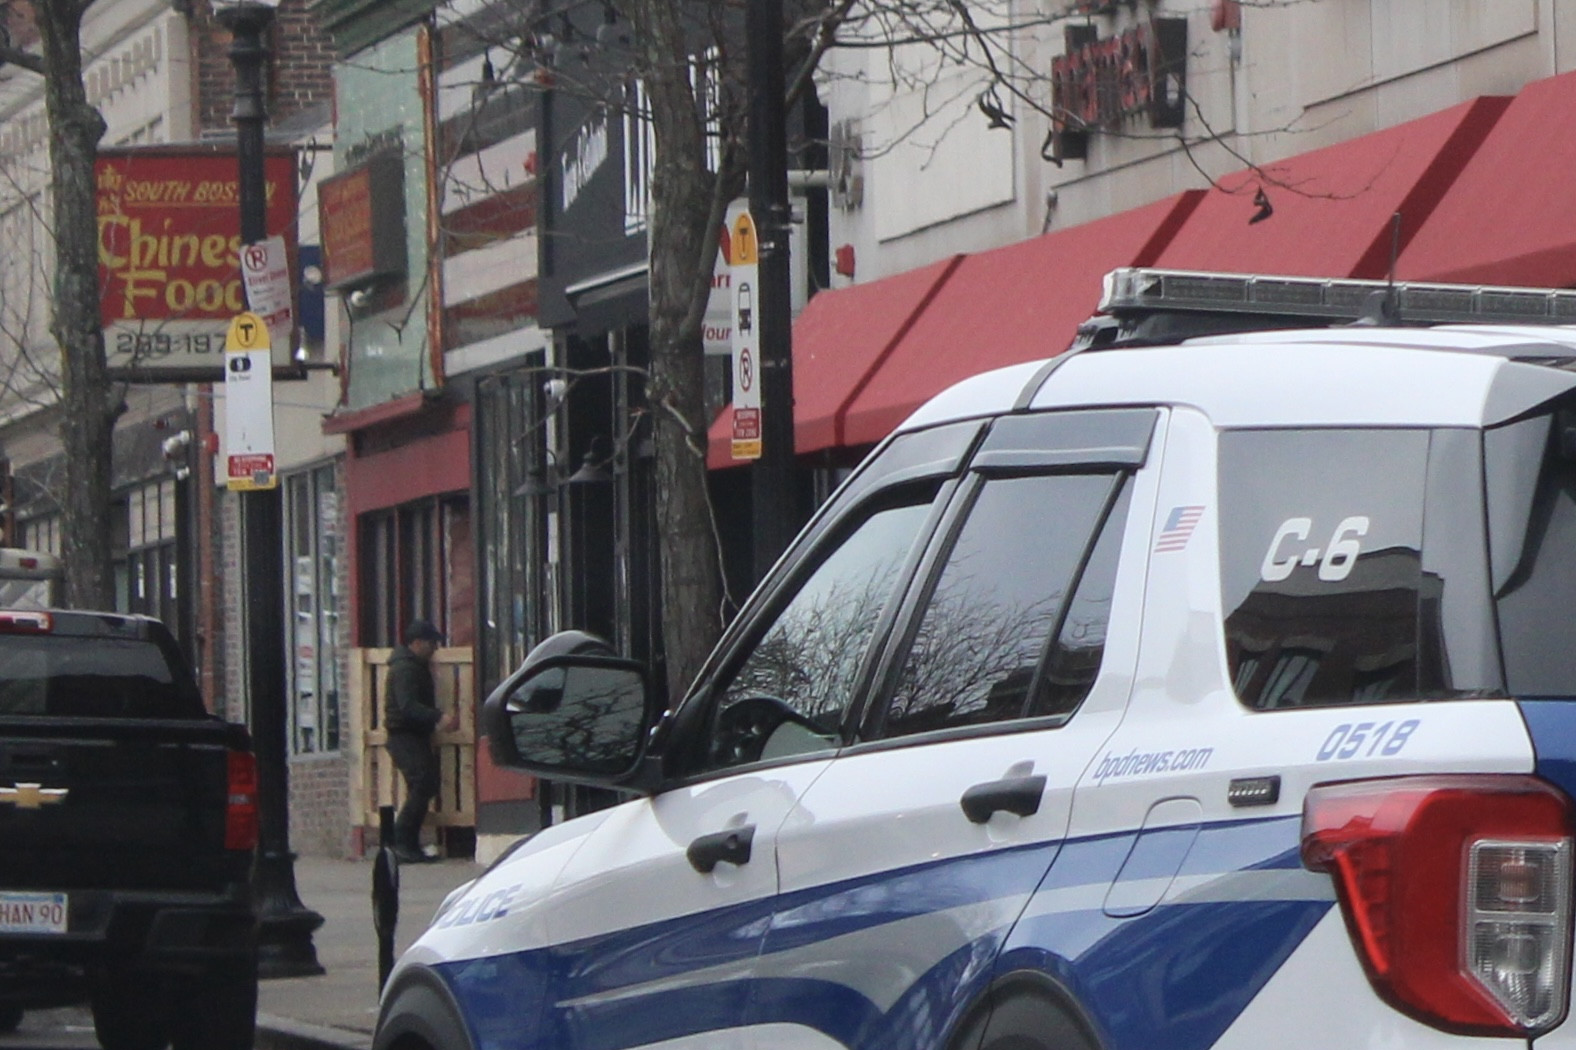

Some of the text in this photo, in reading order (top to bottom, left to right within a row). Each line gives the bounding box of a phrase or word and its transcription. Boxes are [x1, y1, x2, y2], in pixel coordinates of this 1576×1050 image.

[124, 180, 191, 201] SOUTH
[193, 180, 276, 201] BOSN
[97, 214, 243, 268] Chines
[1261, 516, 1369, 582] C-6
[1316, 719, 1421, 761] 0518
[1092, 747, 1214, 788] bpdnews.com
